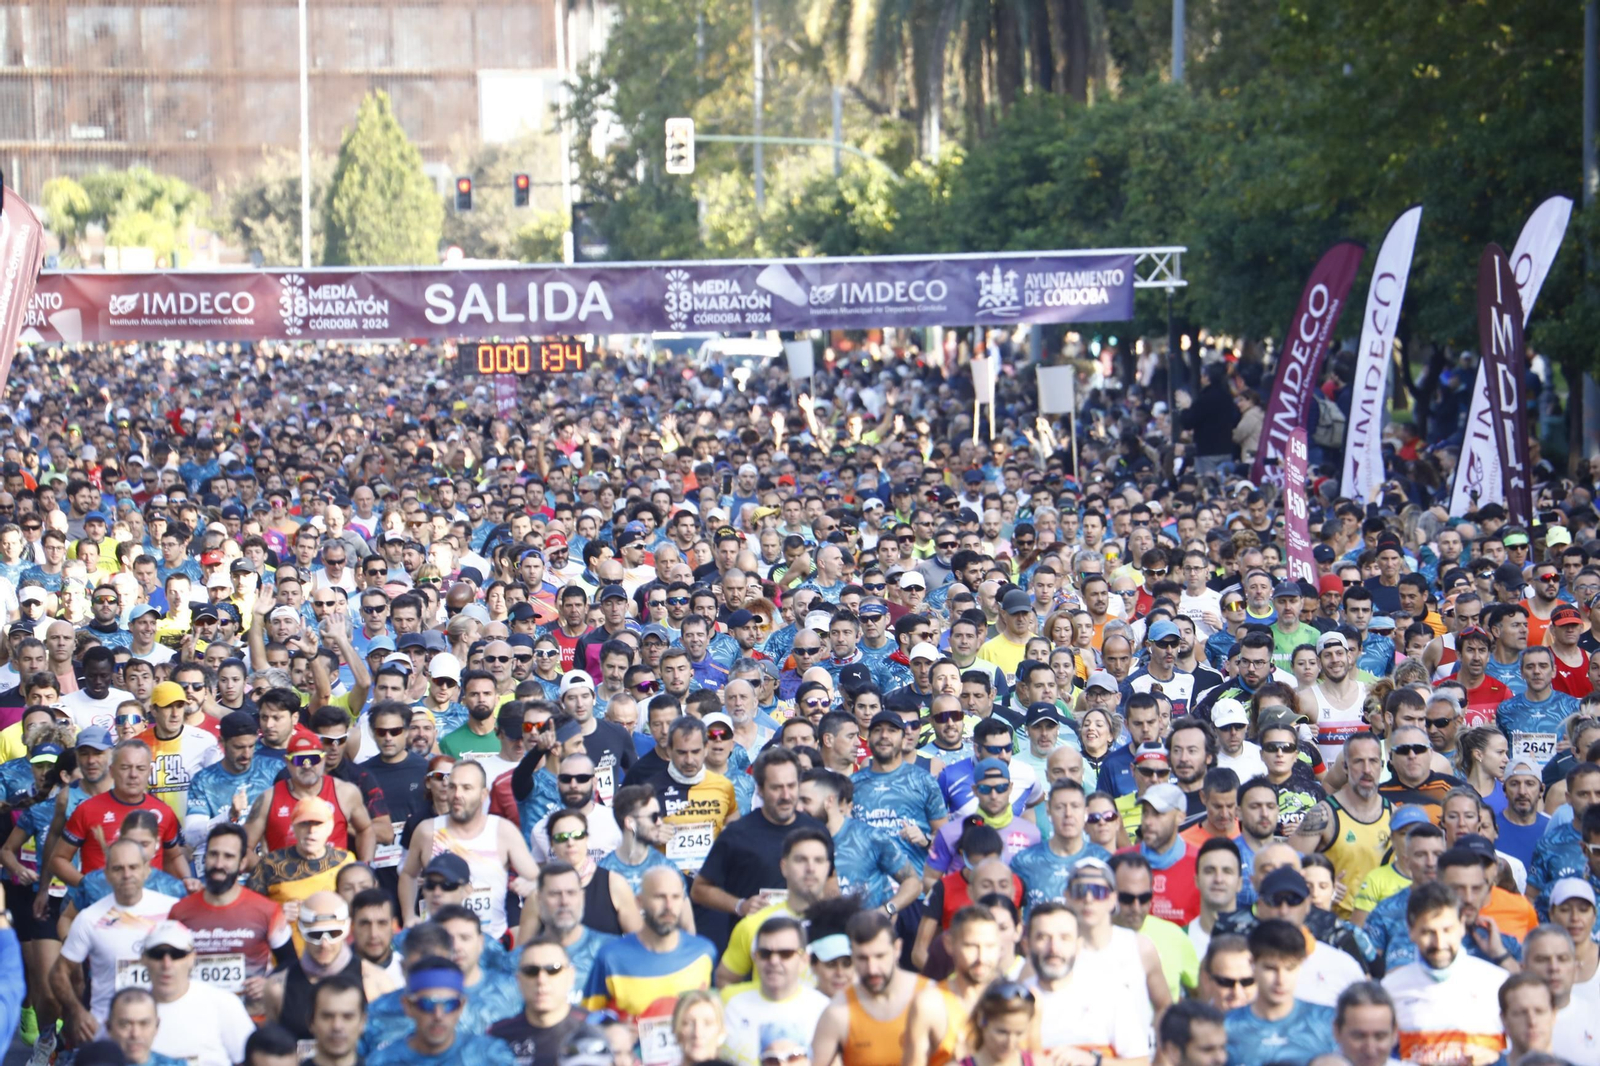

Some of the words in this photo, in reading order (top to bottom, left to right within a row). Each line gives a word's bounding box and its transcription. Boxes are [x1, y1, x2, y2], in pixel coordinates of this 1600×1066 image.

[693, 279, 742, 296] MEDIA
[1024, 268, 1125, 290] AYUNTAMIENTO
[308, 284, 359, 301] MEDIA
[424, 280, 614, 325] SALIDA
[664, 291, 693, 313] 38
[693, 288, 773, 311] MARATÓN
[841, 279, 948, 305] IMDECO
[1024, 290, 1042, 307] DE
[142, 291, 255, 316] IMDECO
[278, 295, 309, 318] 38
[308, 294, 390, 316] MARATÓN
[810, 307, 838, 316] Instituto
[840, 305, 873, 316] Municipal
[874, 305, 883, 314] de
[884, 304, 916, 315] Deportes
[109, 317, 139, 326] Instituto
[140, 317, 177, 327] Municipal
[178, 317, 187, 326] de
[188, 317, 221, 328] Deportes
[222, 316, 254, 326] Córdoba
[308, 317, 358, 330] CÓRDOBA
[361, 317, 389, 330] 2024
[693, 311, 742, 326] CÓRDOBA
[745, 311, 772, 325] 2024
[1269, 283, 1329, 442] IMDECO
[1353, 271, 1397, 448] IMDECO
[1291, 437, 1307, 461] 1:50
[1286, 488, 1306, 520] 1:50
[1288, 555, 1314, 585] 1:50
[1522, 742, 1555, 754] 2647
[597, 775, 612, 789] 14
[865, 808, 898, 820] MEDIA
[678, 833, 712, 849] 2545
[201, 966, 242, 982] 6023
